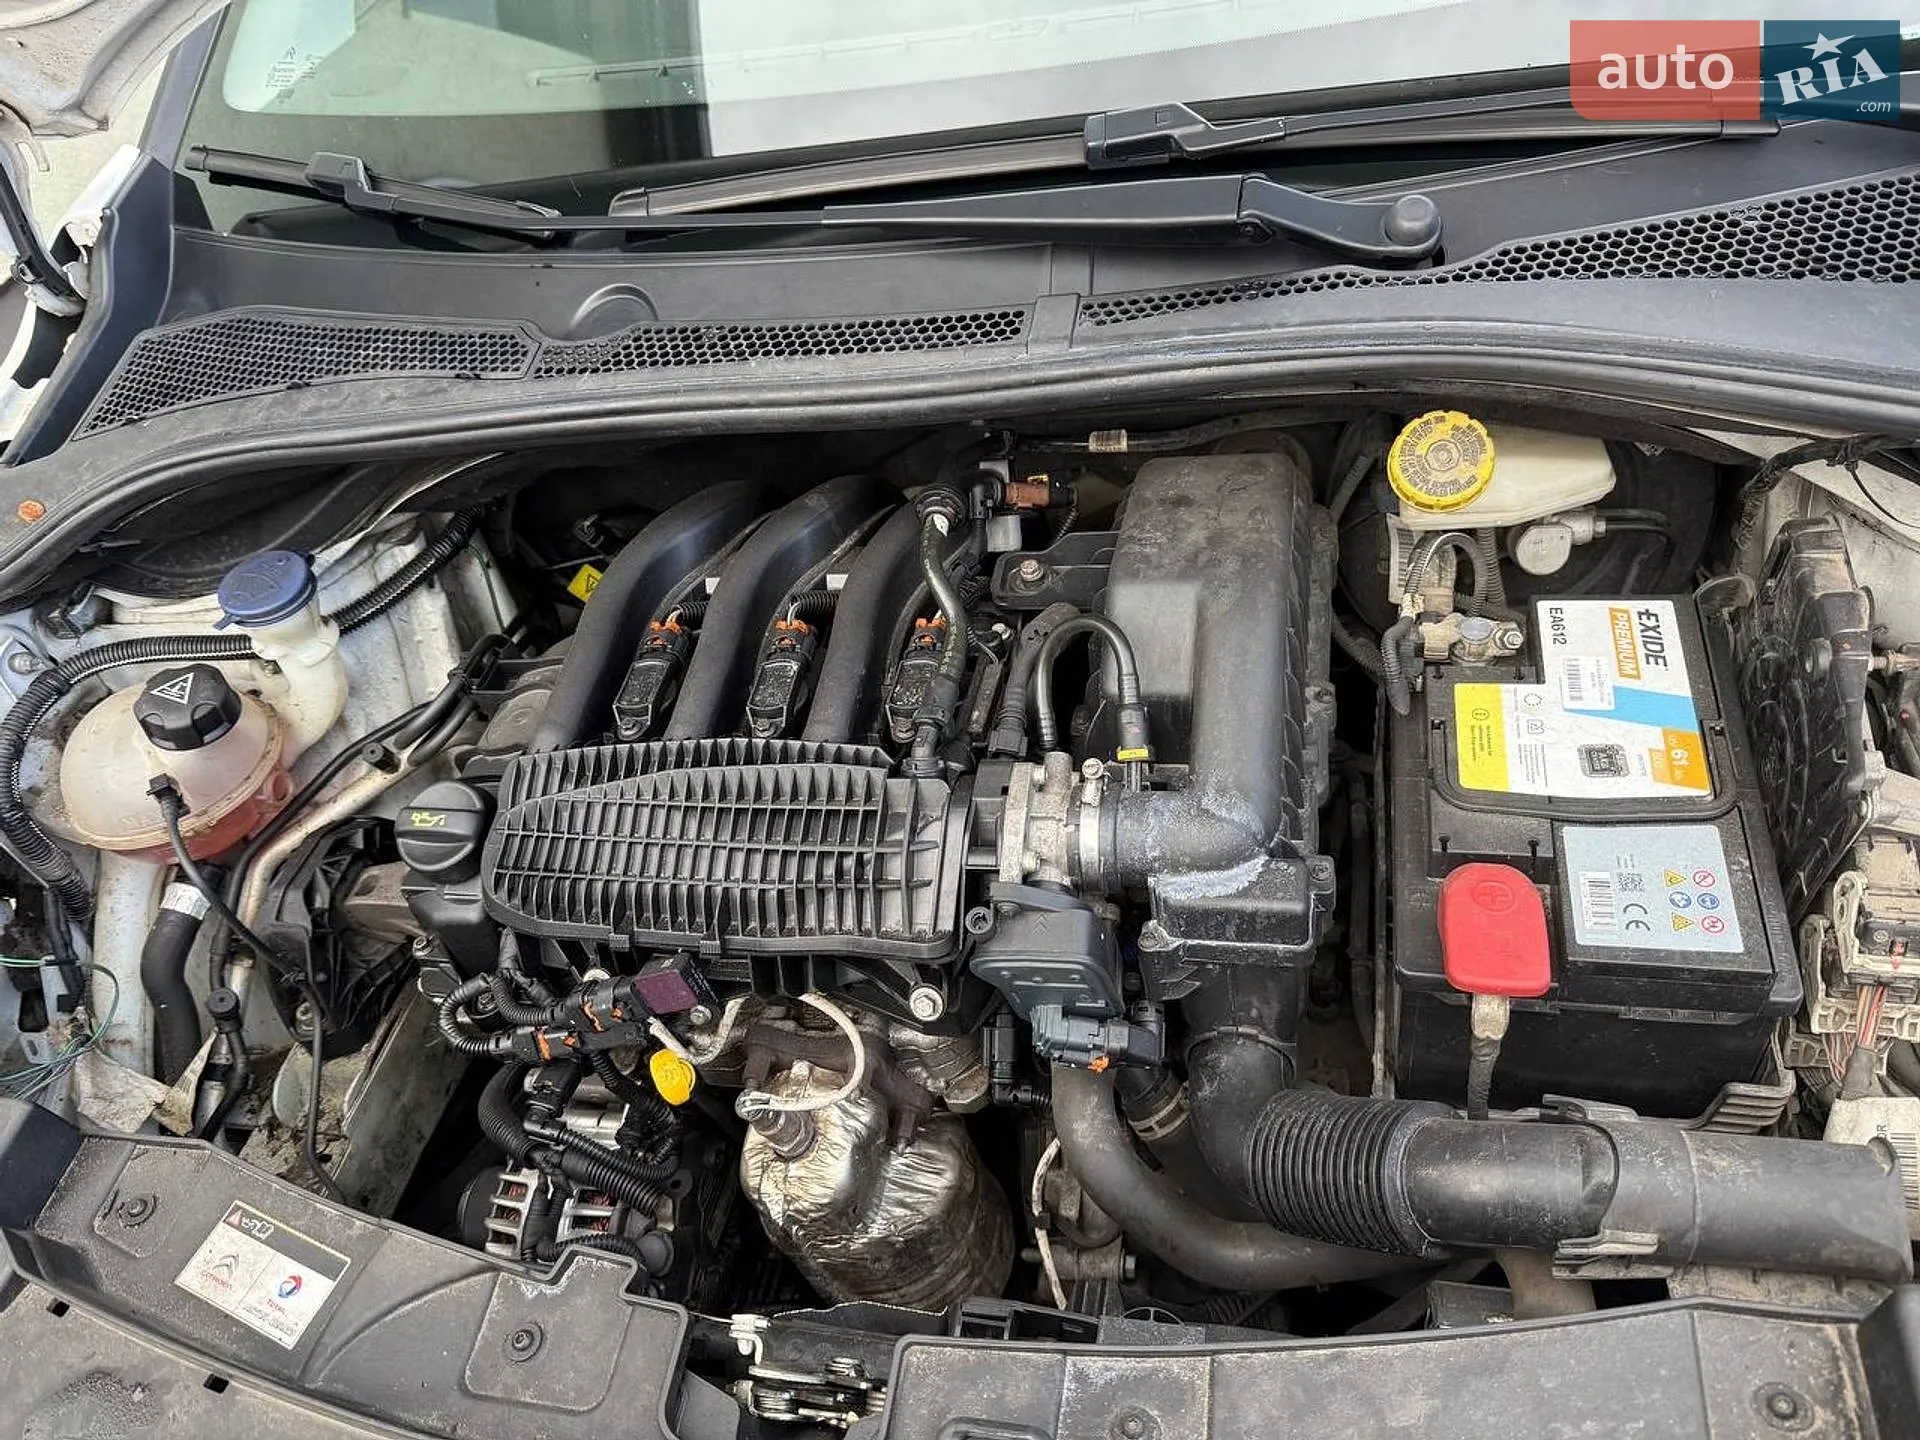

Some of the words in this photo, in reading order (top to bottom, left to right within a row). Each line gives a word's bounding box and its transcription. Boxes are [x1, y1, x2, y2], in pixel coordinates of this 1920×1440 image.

[1550, 607, 1567, 645] EA612
[1614, 610, 1638, 677] PREMIUM
[1637, 608, 1669, 667] EXIDE
